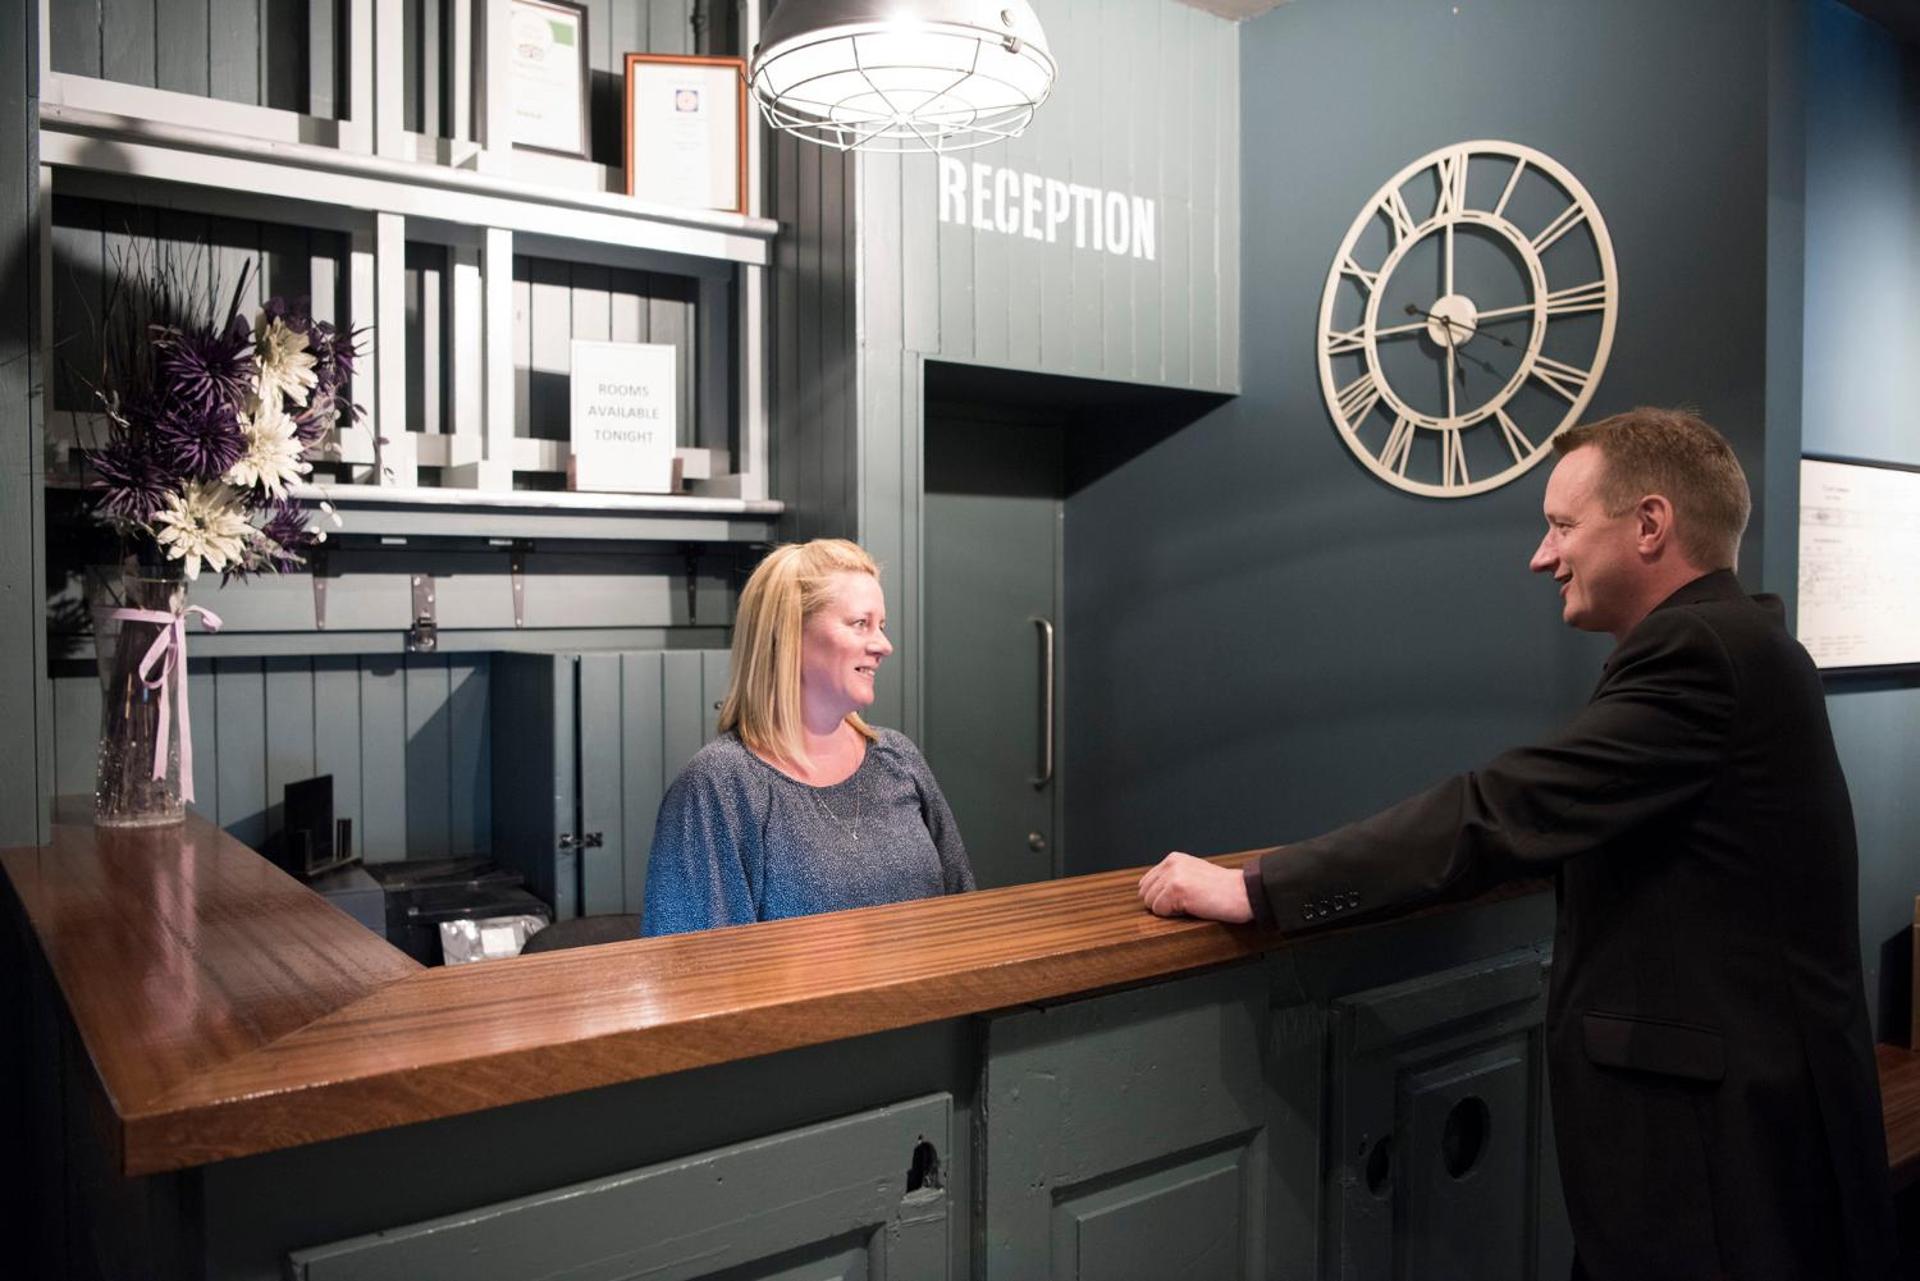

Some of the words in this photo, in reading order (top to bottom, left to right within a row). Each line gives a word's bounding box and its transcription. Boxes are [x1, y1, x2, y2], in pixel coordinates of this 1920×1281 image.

[938, 155, 1156, 261] RECEPTION
[598, 383, 649, 397] ROOMS
[587, 404, 660, 420] AVAILABLE
[593, 429, 654, 443] TONIGHT
